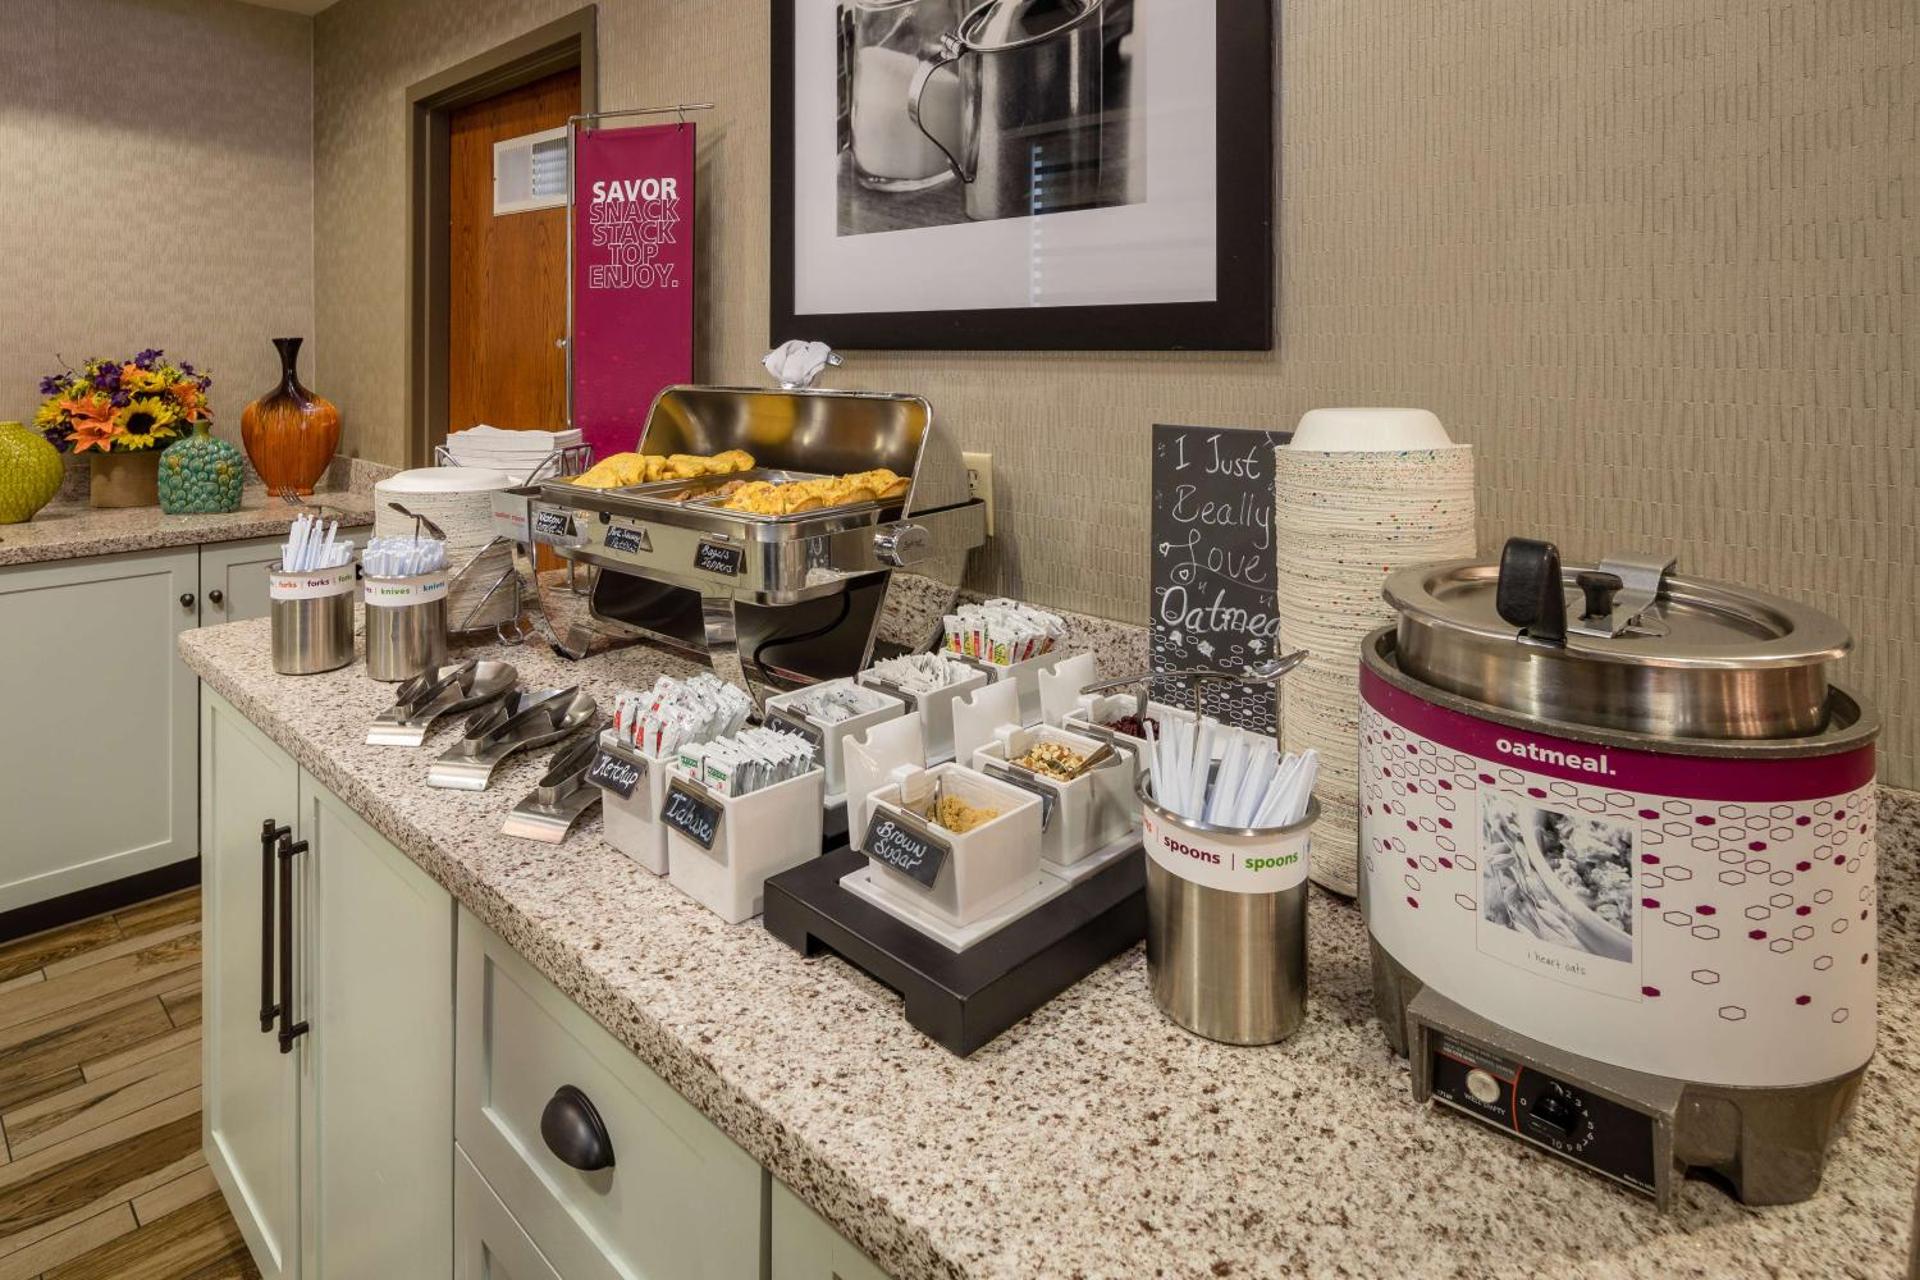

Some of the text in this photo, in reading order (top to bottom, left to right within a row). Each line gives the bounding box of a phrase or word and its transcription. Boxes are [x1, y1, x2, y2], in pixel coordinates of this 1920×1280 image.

[592, 177, 677, 203] SAVOR
[590, 198, 680, 224] SNACK
[592, 220, 677, 246] STACK
[607, 243, 660, 267] TOP
[589, 263, 679, 289] ENJOY.
[1175, 433, 1261, 480] I Just
[1171, 484, 1271, 550] Really
[1168, 528, 1268, 586] Love
[307, 579, 330, 588] forks
[380, 586, 411, 595] knives
[1161, 584, 1281, 639] Oatmea
[1495, 738, 1617, 776] oatmeal.
[873, 838, 923, 870] Sugar
[876, 821, 928, 858] Brown
[1163, 835, 1299, 872] spoons spoons
